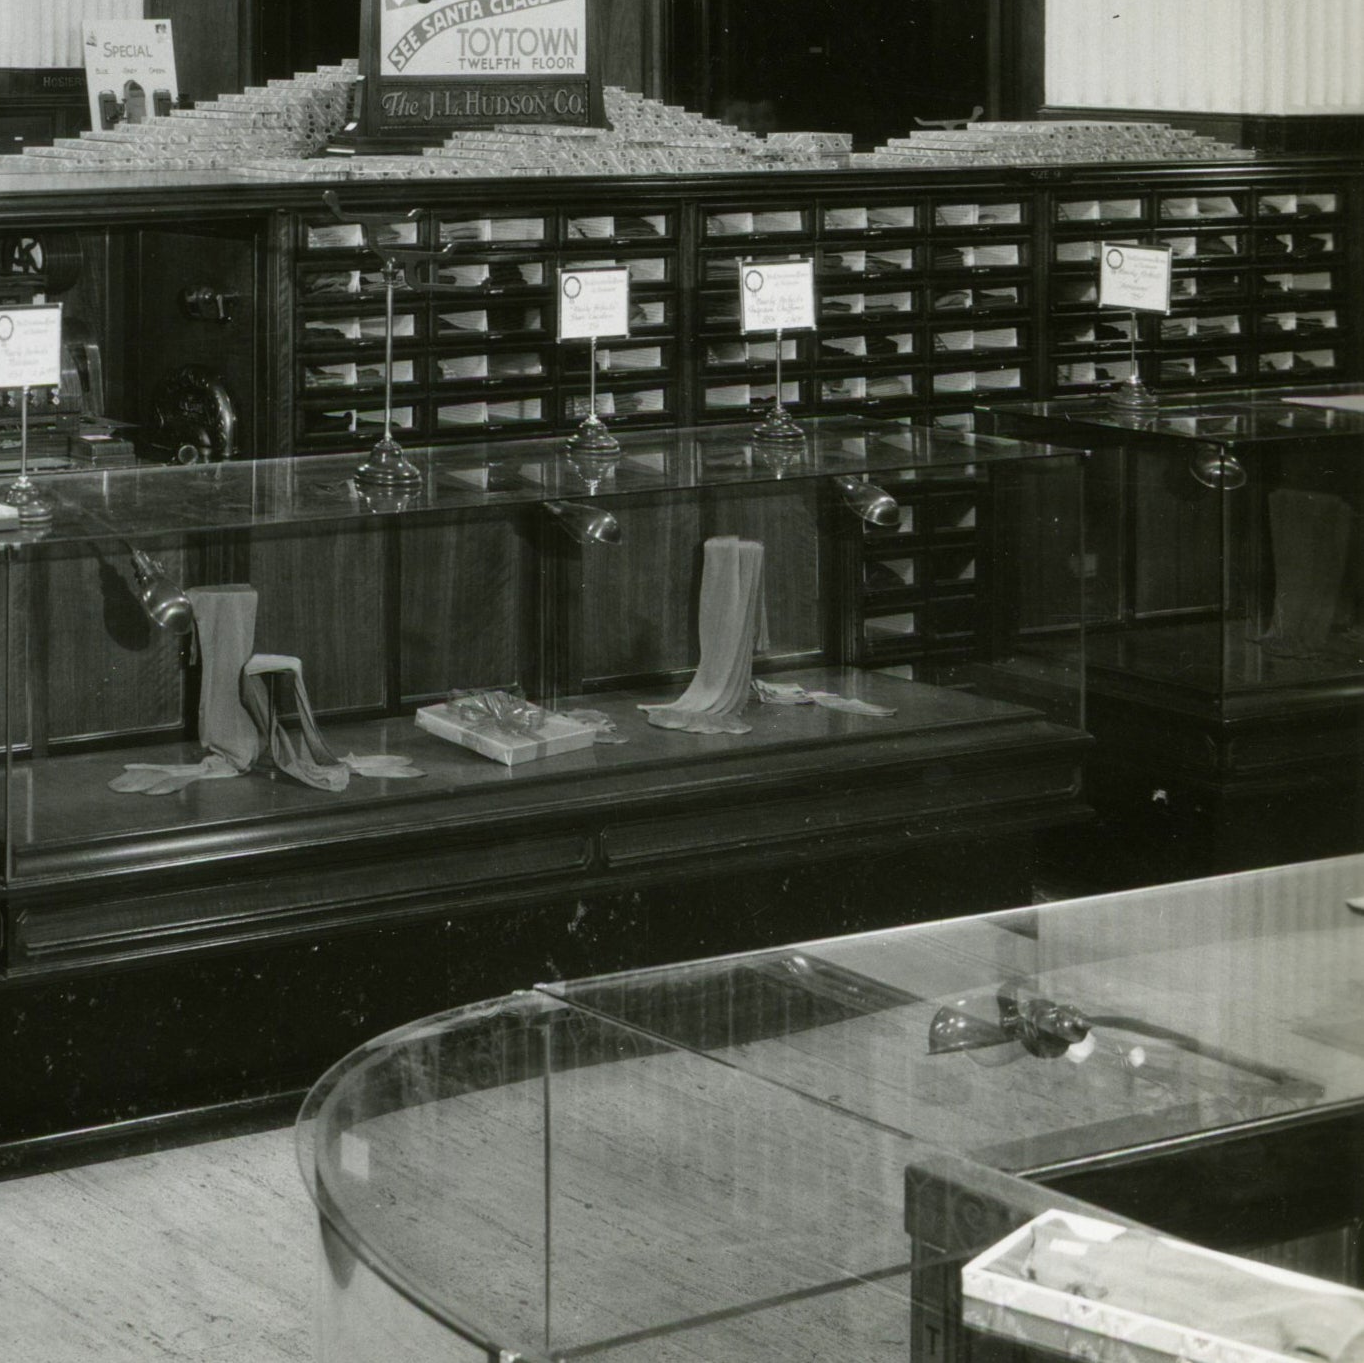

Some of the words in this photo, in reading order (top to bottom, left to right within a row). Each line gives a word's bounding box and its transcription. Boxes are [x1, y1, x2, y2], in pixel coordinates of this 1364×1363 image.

[390, 35, 420, 70] SEE
[425, 0, 483, 37] SANTA
[457, 27, 578, 57] TOYTOWN
[103, 41, 154, 58] SPECIAL
[458, 57, 521, 70] TWELFTH
[532, 57, 575, 70] FLOOR
[381, 91, 419, 116] The
